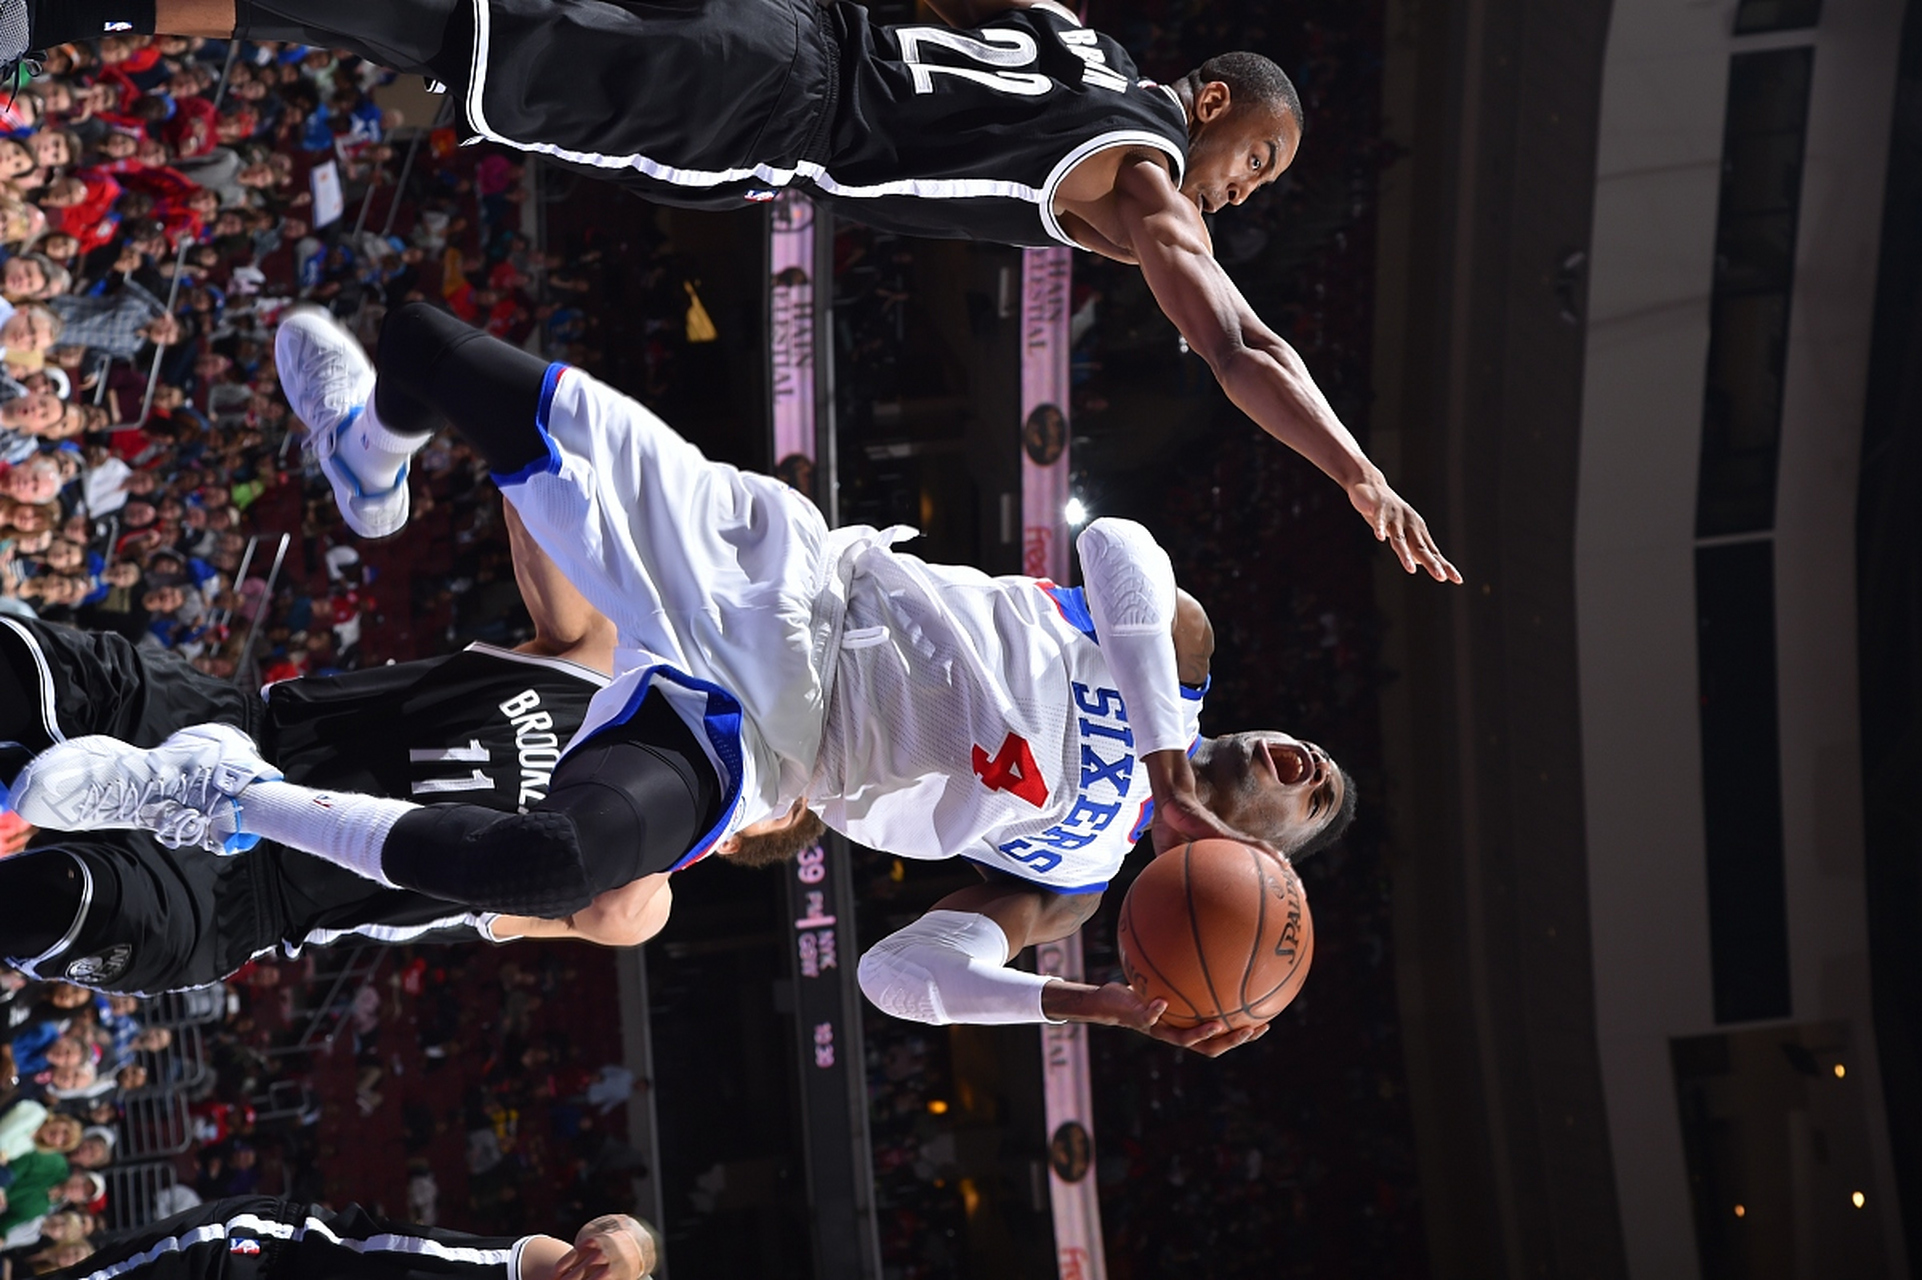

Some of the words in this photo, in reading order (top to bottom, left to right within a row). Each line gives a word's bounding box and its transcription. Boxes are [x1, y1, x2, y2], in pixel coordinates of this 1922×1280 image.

[896, 28, 1053, 95] 22
[1028, 249, 1047, 355] ELESTIAL
[1047, 259, 1068, 322] HAIN
[773, 288, 793, 404] ELESTIAL
[794, 302, 813, 367] HAIN
[409, 739, 495, 794] 11
[499, 689, 561, 814] BROOKL
[972, 732, 1049, 809] 4
[999, 681, 1134, 873] SIXERS
